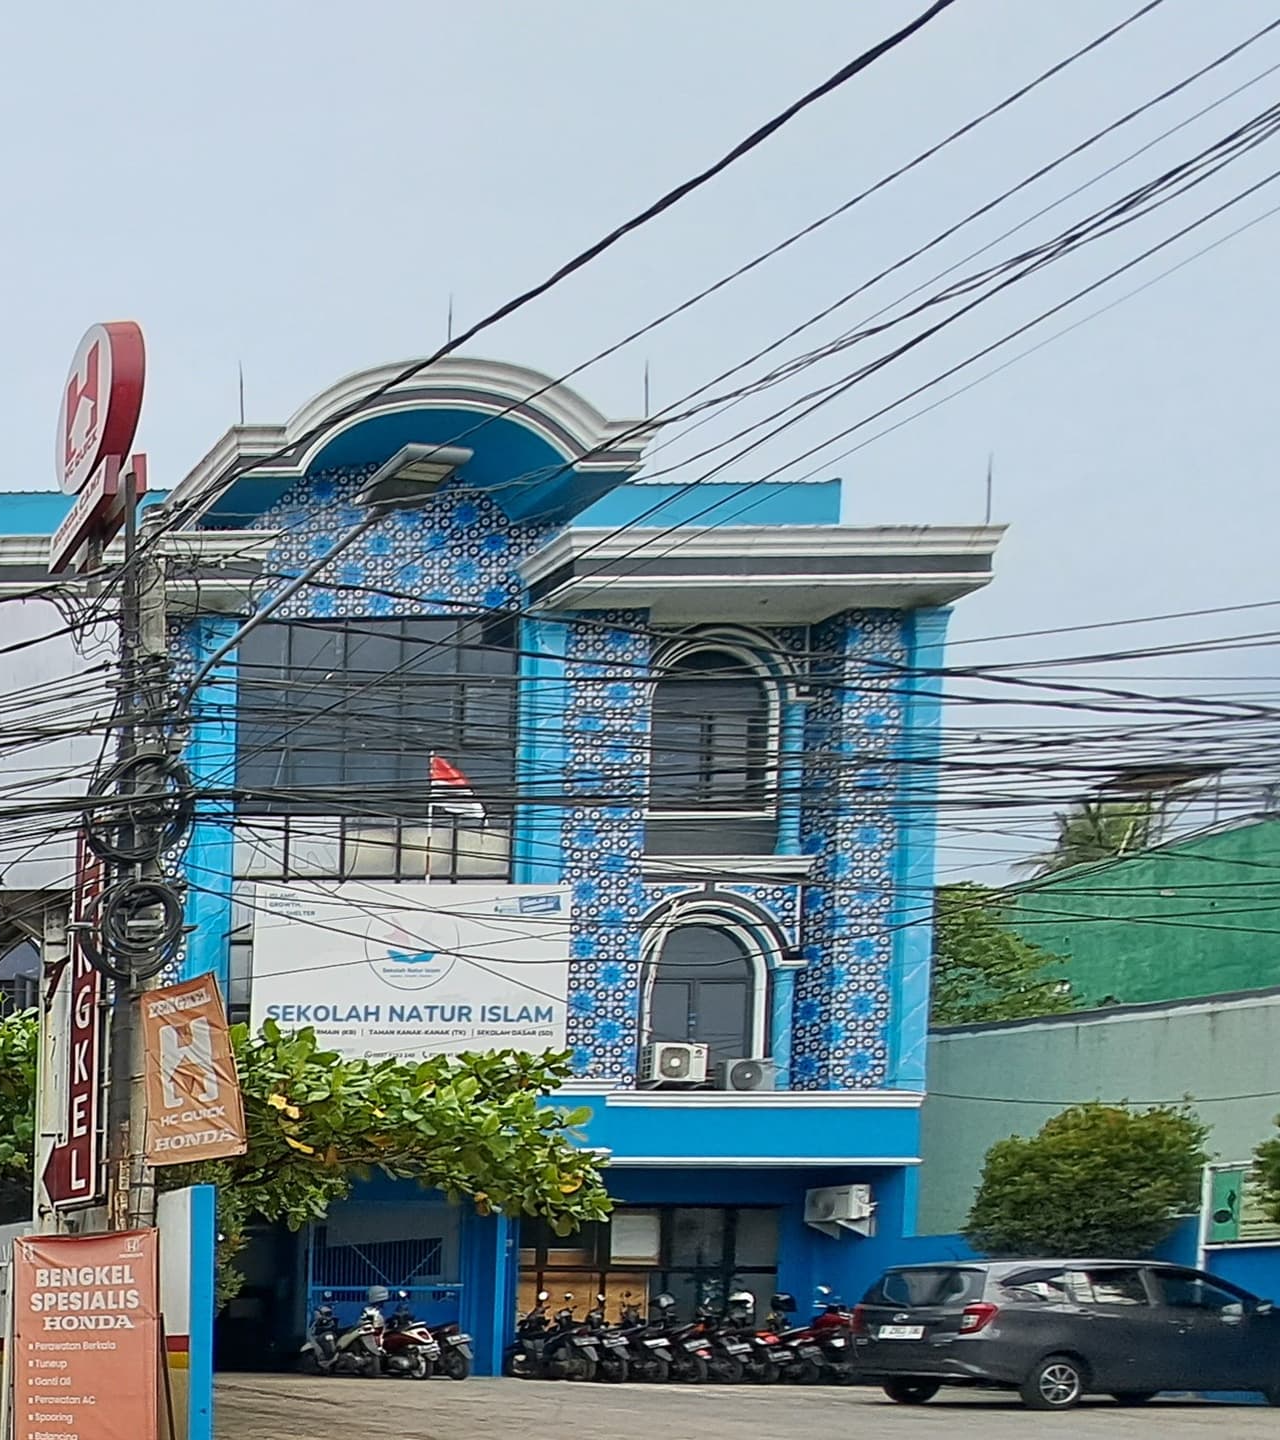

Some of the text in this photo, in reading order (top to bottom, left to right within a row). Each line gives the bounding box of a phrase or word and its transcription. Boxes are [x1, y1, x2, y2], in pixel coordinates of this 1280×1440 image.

[266, 1004, 553, 1024] SEKOLAH NATUR ISLAM
[476, 1028, 510, 1036] SEKOLAH
[154, 1127, 235, 1152] HONDA
[35, 1264, 135, 1288] BENGKEL
[30, 1288, 140, 1312] SPESIALIS
[42, 1314, 136, 1331] HONDA
[34, 1359, 68, 1370] Tuneup
[82, 1395, 97, 1405] AC
